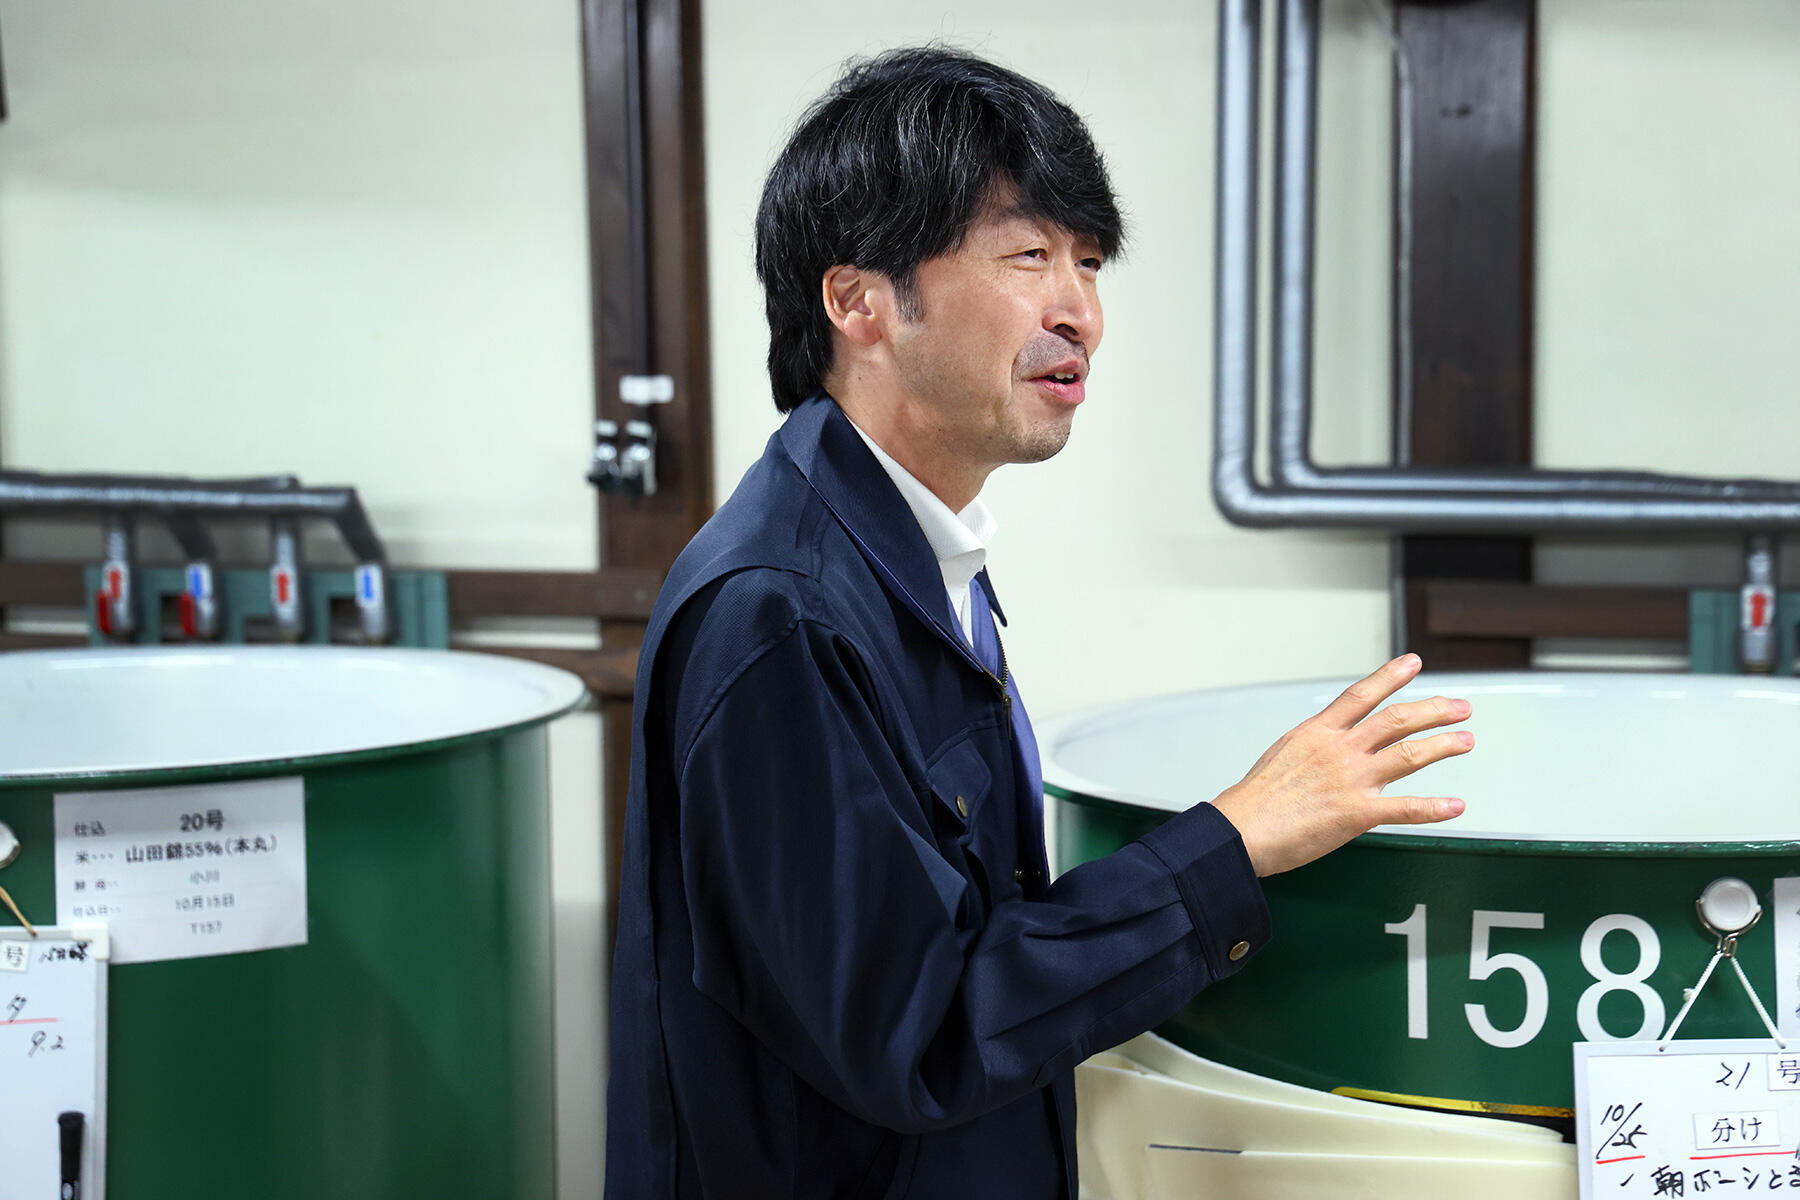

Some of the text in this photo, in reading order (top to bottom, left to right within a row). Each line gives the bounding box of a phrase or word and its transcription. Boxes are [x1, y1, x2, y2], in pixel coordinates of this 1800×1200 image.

[180, 809, 225, 832] 20号
[1384, 903, 1667, 1048] 158
[1776, 1059, 1800, 1085] 号
[1711, 1116, 1763, 1144] 分け
